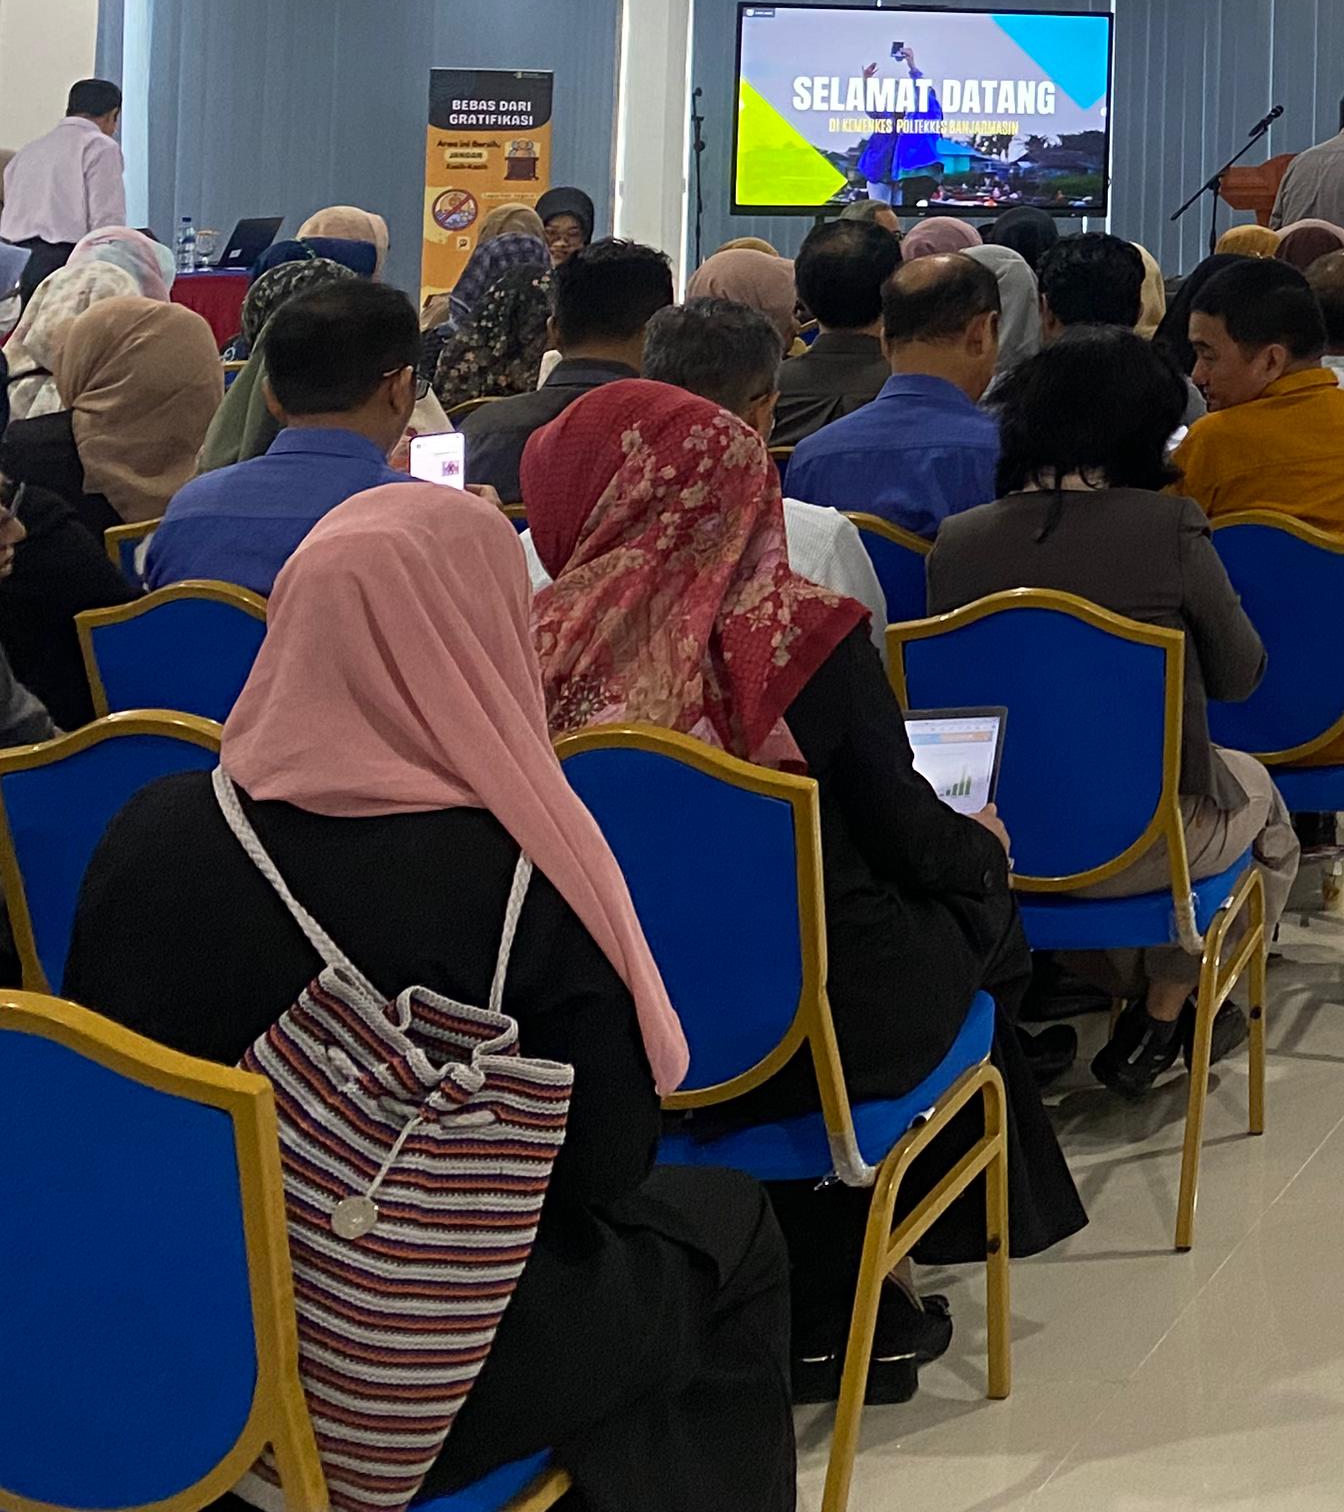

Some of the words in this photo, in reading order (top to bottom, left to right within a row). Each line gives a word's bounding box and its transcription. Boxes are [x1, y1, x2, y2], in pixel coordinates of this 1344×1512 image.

[792, 76, 932, 113] SELAMAT
[941, 79, 1056, 115] DATANG
[452, 100, 496, 110] BEBAS
[499, 101, 532, 112] DARI
[449, 114, 533, 126] GRATIFIKASI
[829, 118, 839, 132] DI
[841, 118, 893, 133] KEMENKES
[896, 119, 945, 134] POLTEKKES
[948, 120, 1019, 135] BANJARMASIN
